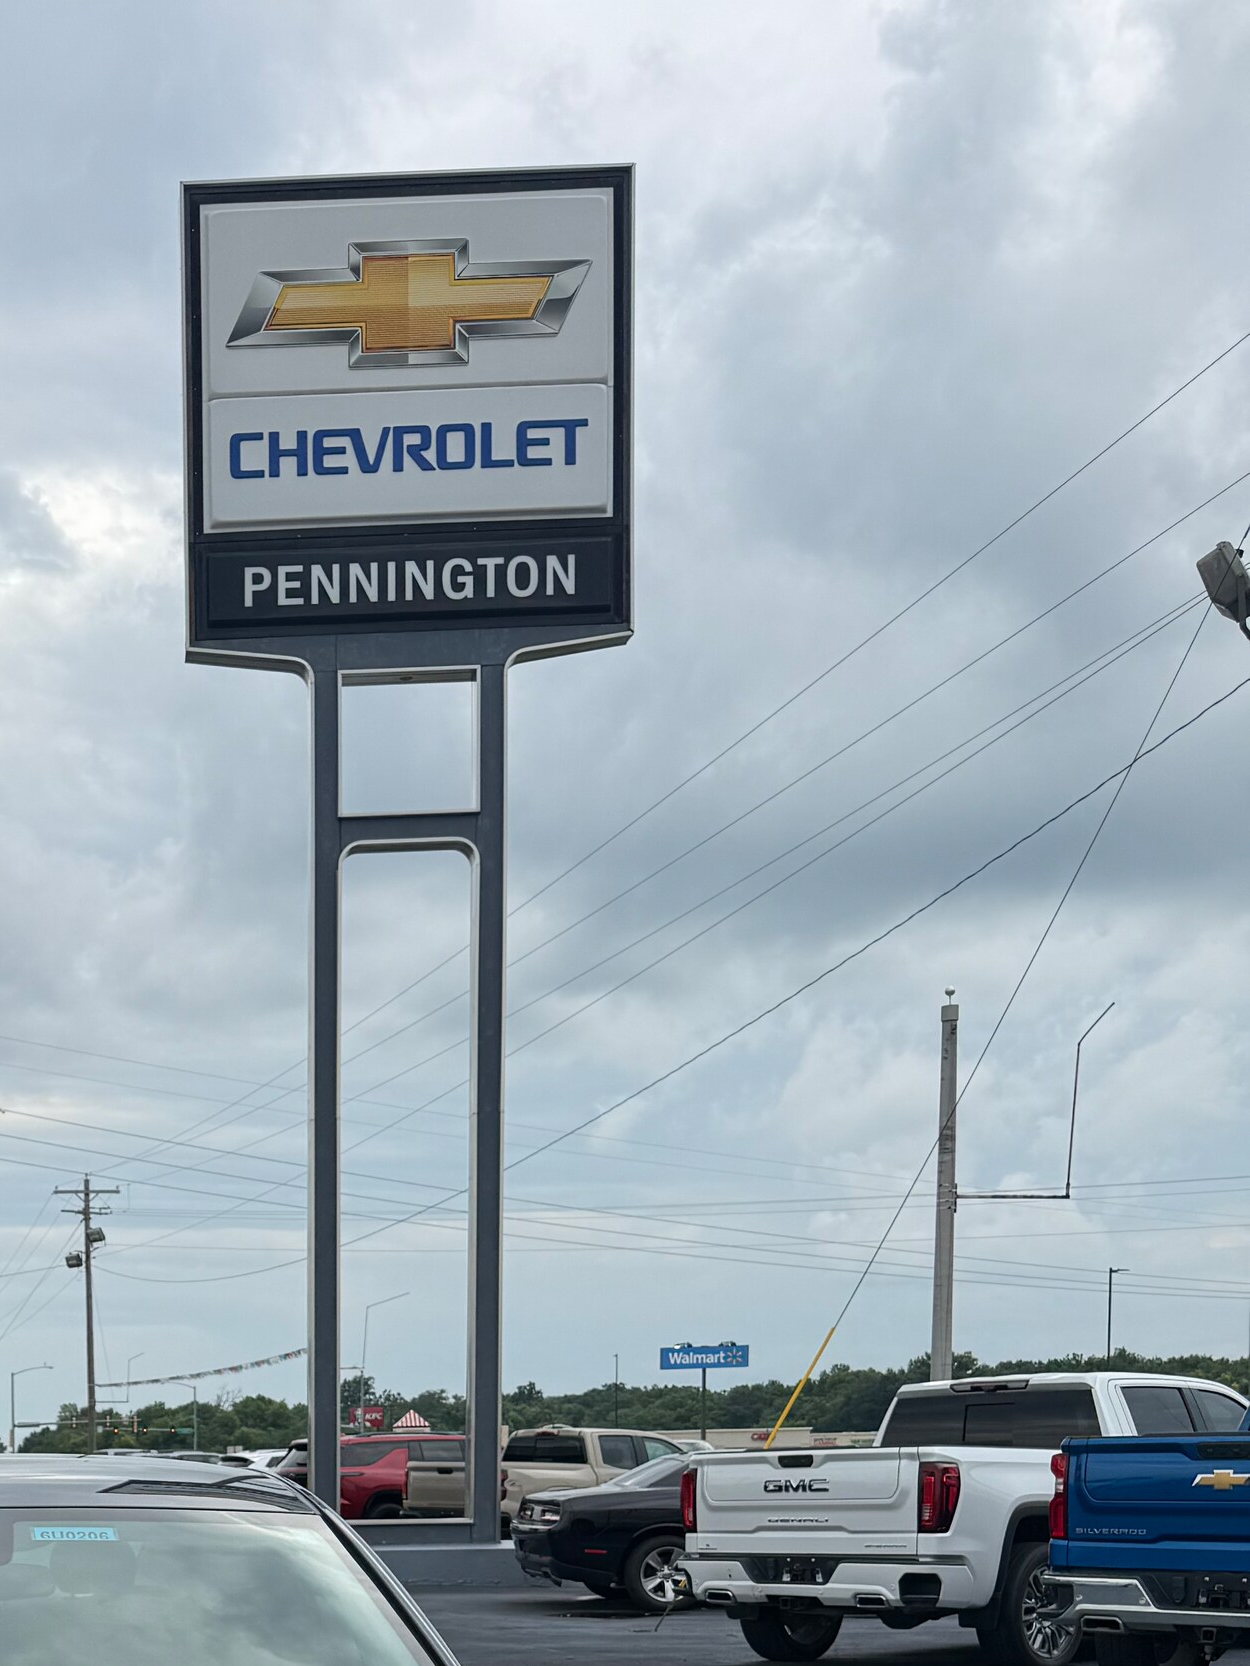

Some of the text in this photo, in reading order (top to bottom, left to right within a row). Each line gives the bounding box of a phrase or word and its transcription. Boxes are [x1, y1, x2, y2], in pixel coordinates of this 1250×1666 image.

[229, 417, 589, 480] CHEVROLET
[243, 553, 577, 608] PENNINGTON
[668, 1350, 725, 1365] Walmart
[364, 1412, 383, 1420] KFC
[763, 1478, 830, 1493] GMC
[1075, 1527, 1147, 1535] SILVERADO
